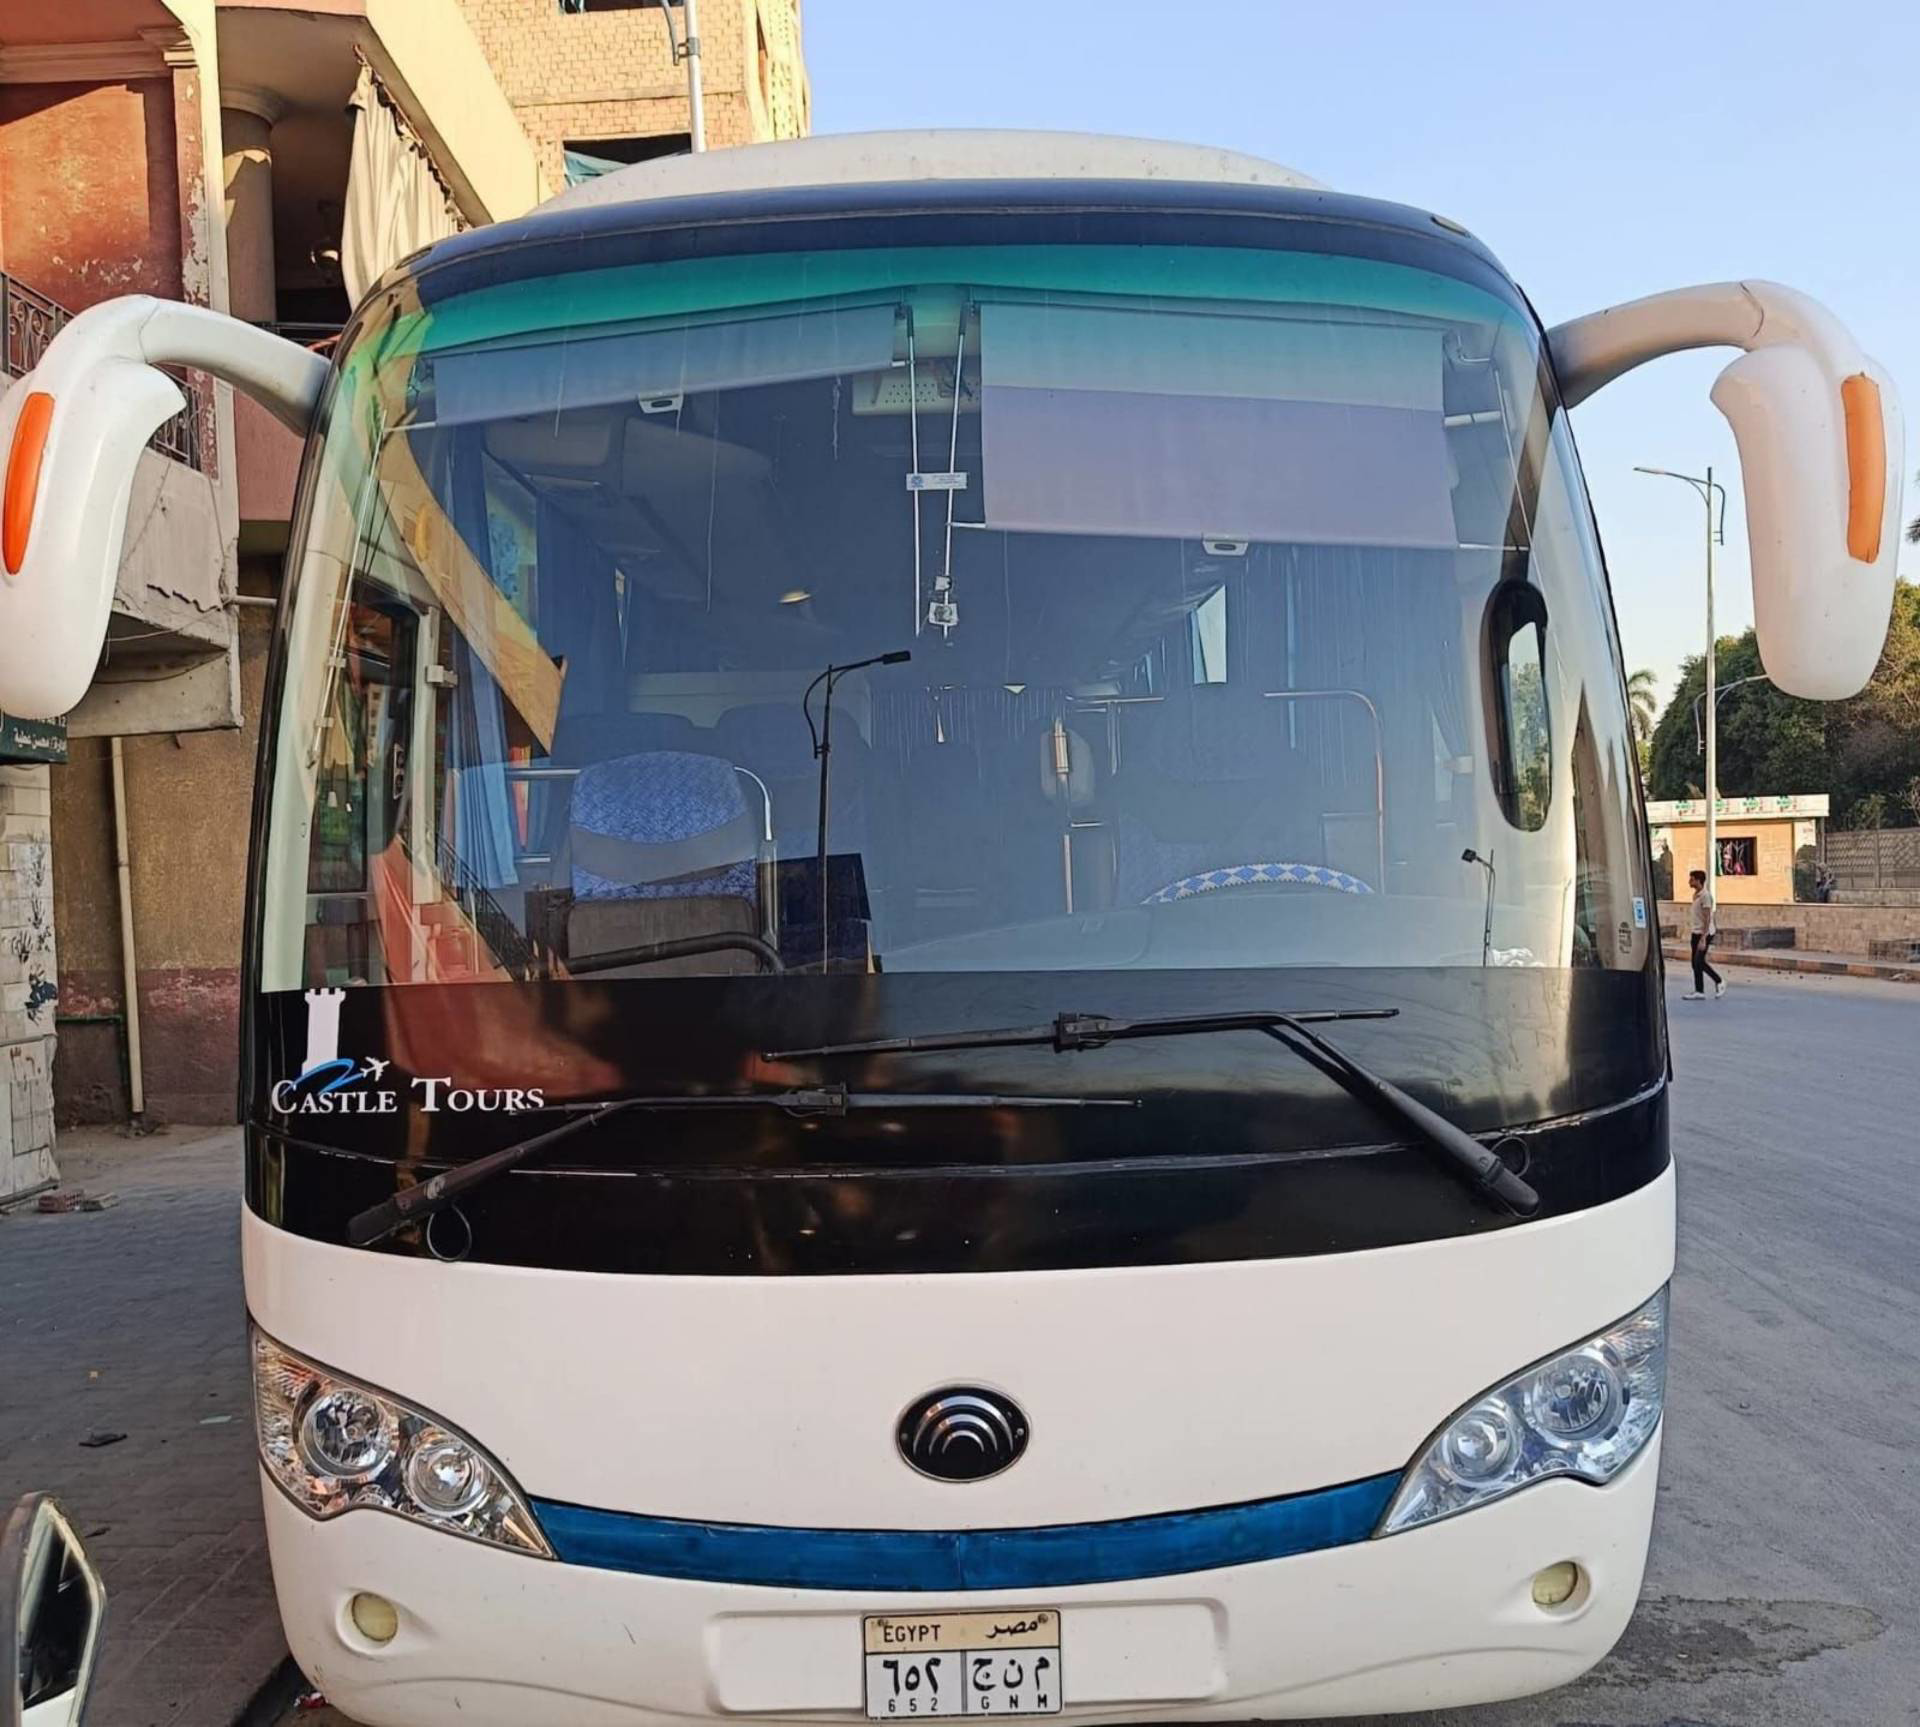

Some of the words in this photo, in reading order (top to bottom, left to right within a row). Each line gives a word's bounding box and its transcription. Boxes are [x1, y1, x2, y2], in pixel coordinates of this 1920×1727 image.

[271, 1079, 398, 1114] CASTLE
[410, 1077, 545, 1114] TOURS
[883, 1624, 941, 1643] EGYPT
[985, 1619, 1038, 1639] مصر
[883, 1657, 942, 1696] ٦٥٢
